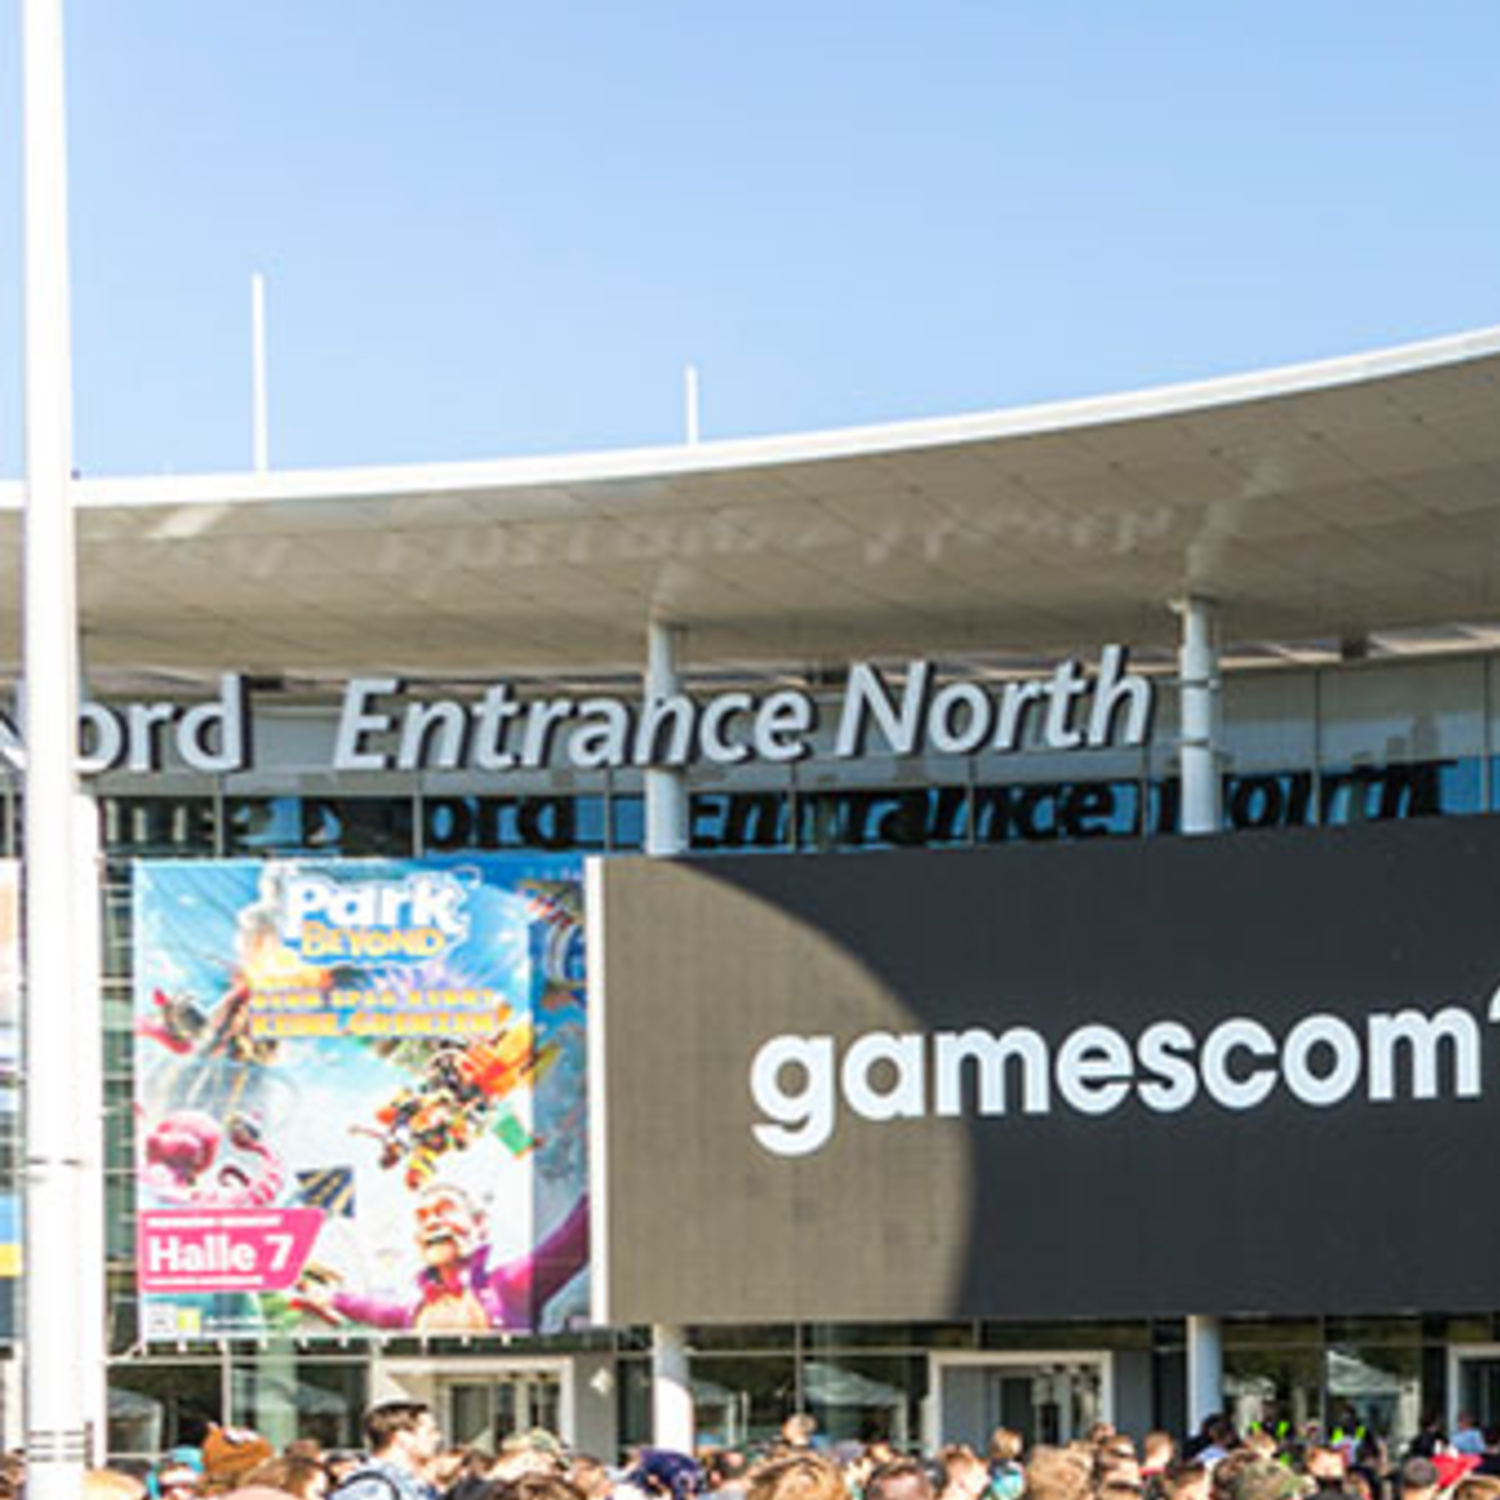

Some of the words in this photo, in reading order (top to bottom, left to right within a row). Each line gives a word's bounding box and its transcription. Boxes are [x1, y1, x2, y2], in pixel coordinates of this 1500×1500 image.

[0, 672, 244, 773] ord
[334, 677, 808, 771] Entrance
[835, 645, 1151, 757] North
[284, 873, 468, 942] Park
[149, 1234, 257, 1272] Halle
[264, 1234, 294, 1271] 7
